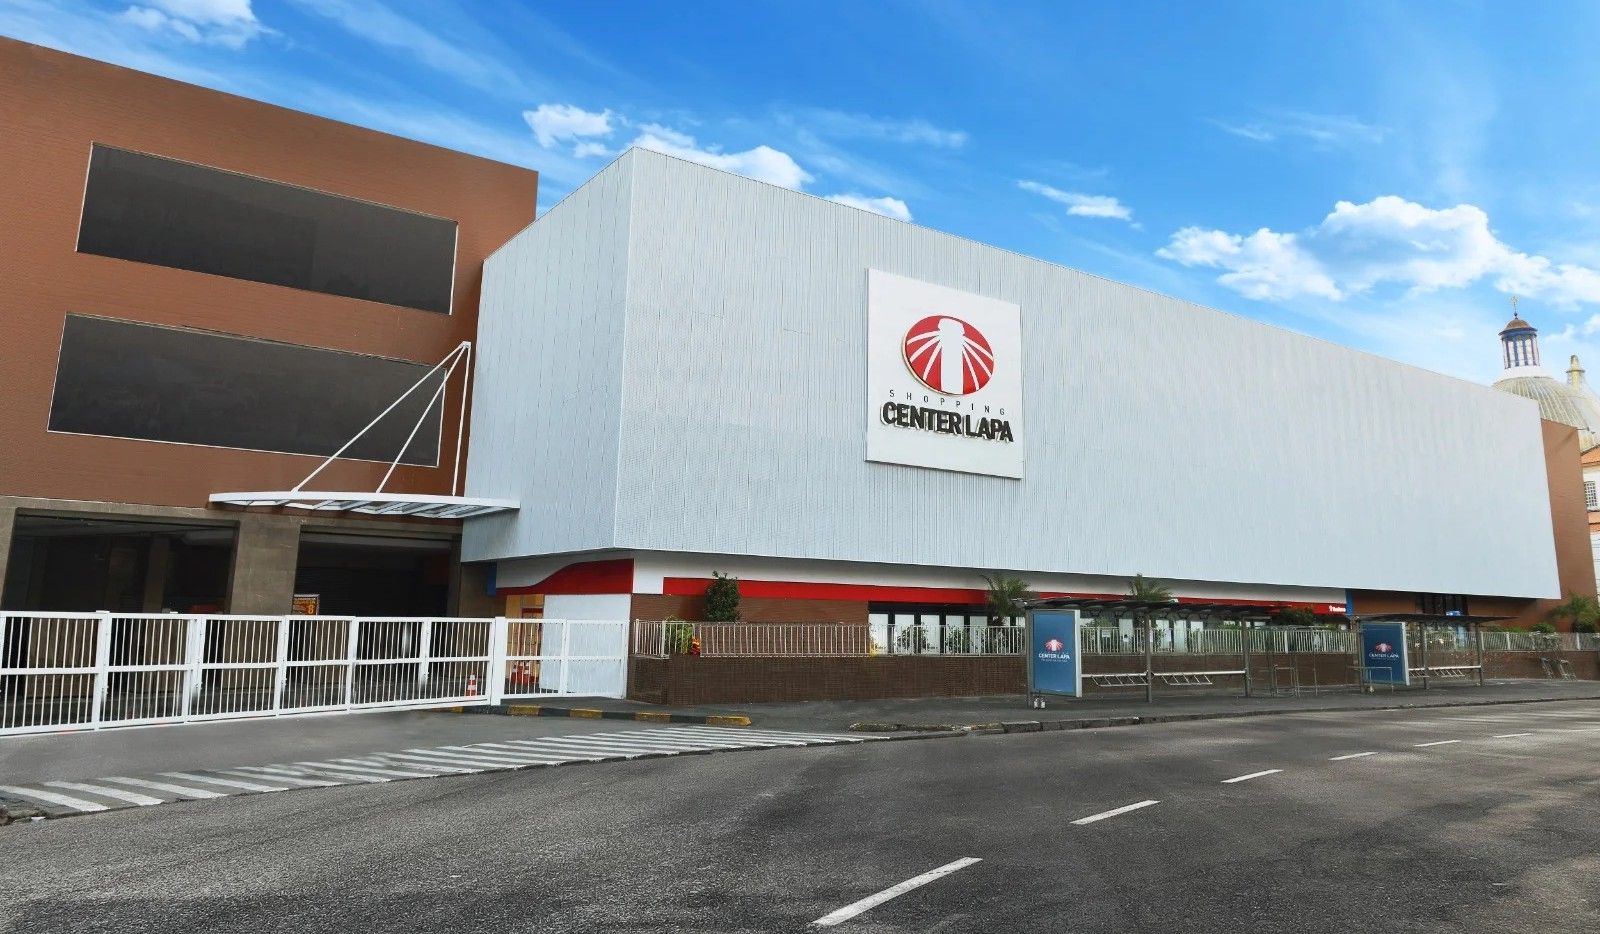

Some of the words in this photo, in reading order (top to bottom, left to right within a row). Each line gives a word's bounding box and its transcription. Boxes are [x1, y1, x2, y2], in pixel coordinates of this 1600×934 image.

[889, 389, 1005, 416] SHOPPING
[880, 401, 962, 436] CENTER
[963, 414, 1014, 443] LAPA
